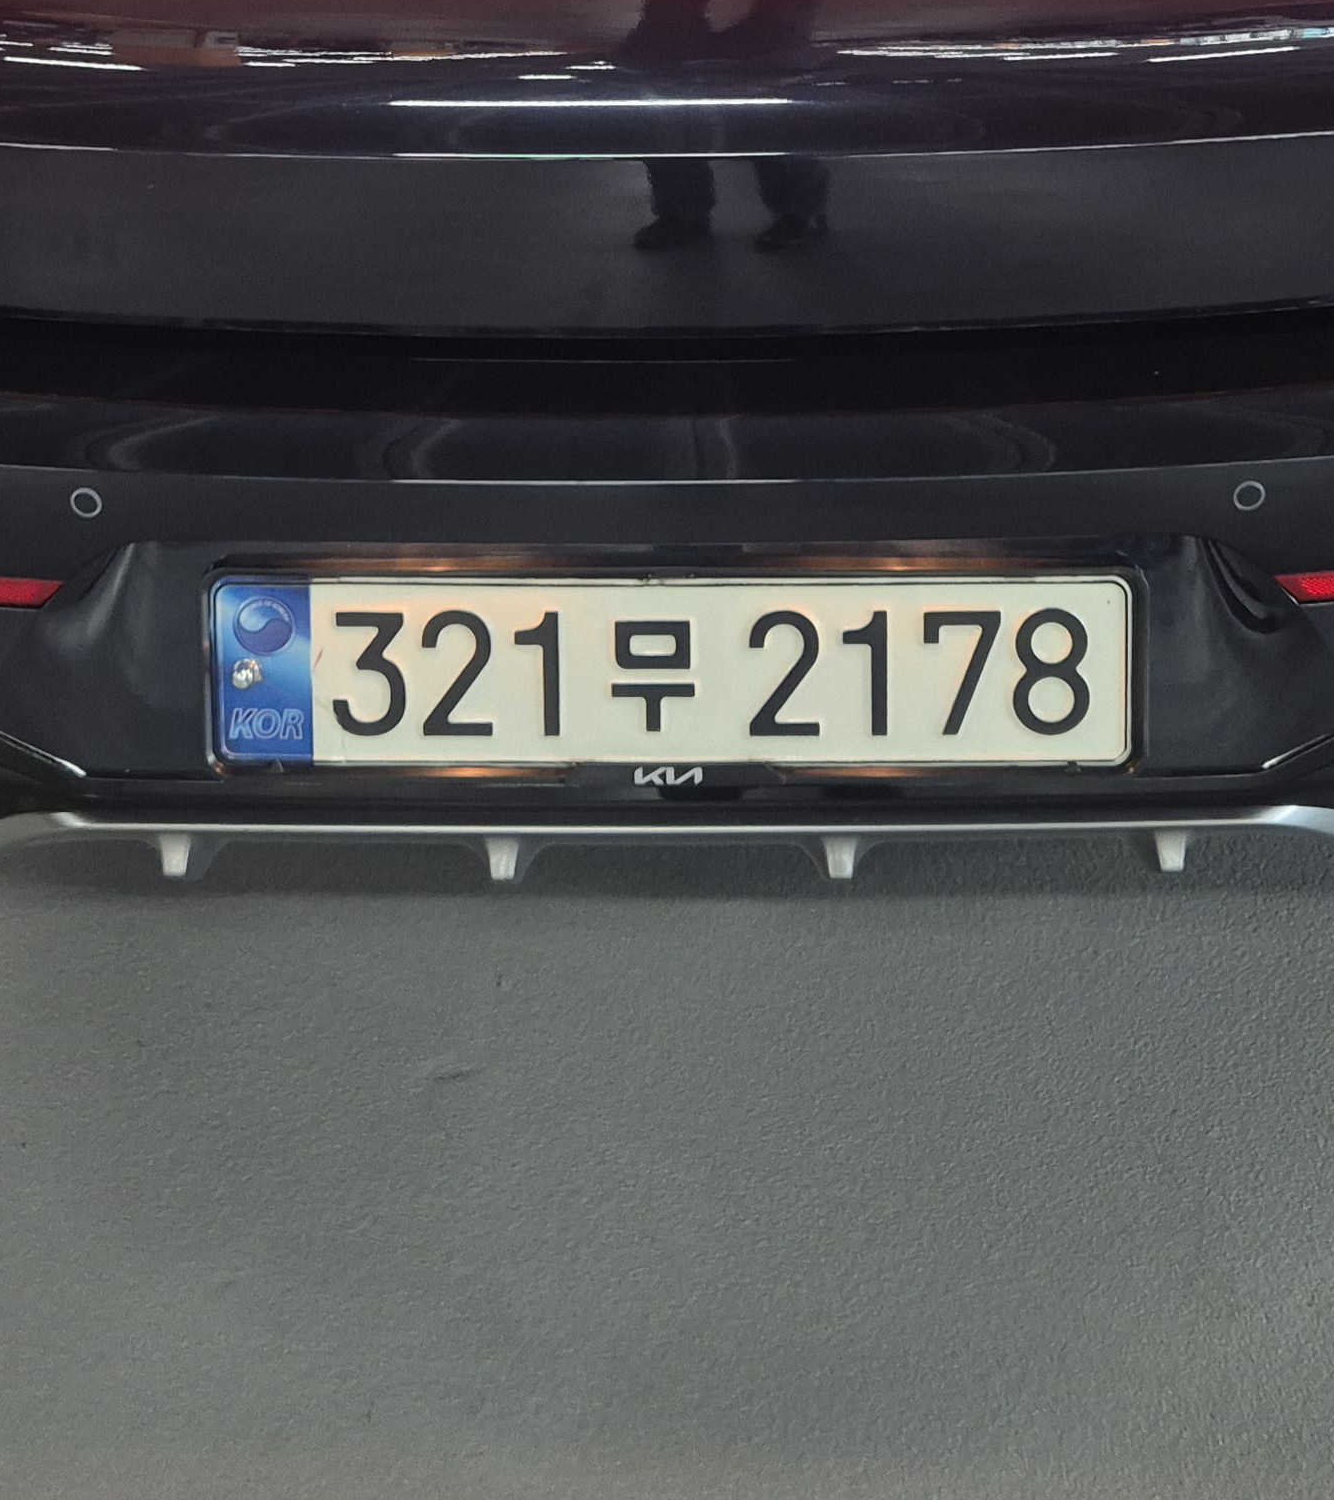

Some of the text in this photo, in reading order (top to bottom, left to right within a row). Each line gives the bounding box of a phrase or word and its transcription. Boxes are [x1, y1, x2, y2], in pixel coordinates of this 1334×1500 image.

[331, 606, 1092, 738] 321무 2178
[228, 706, 305, 740] KOR
[633, 766, 703, 786] KIA
